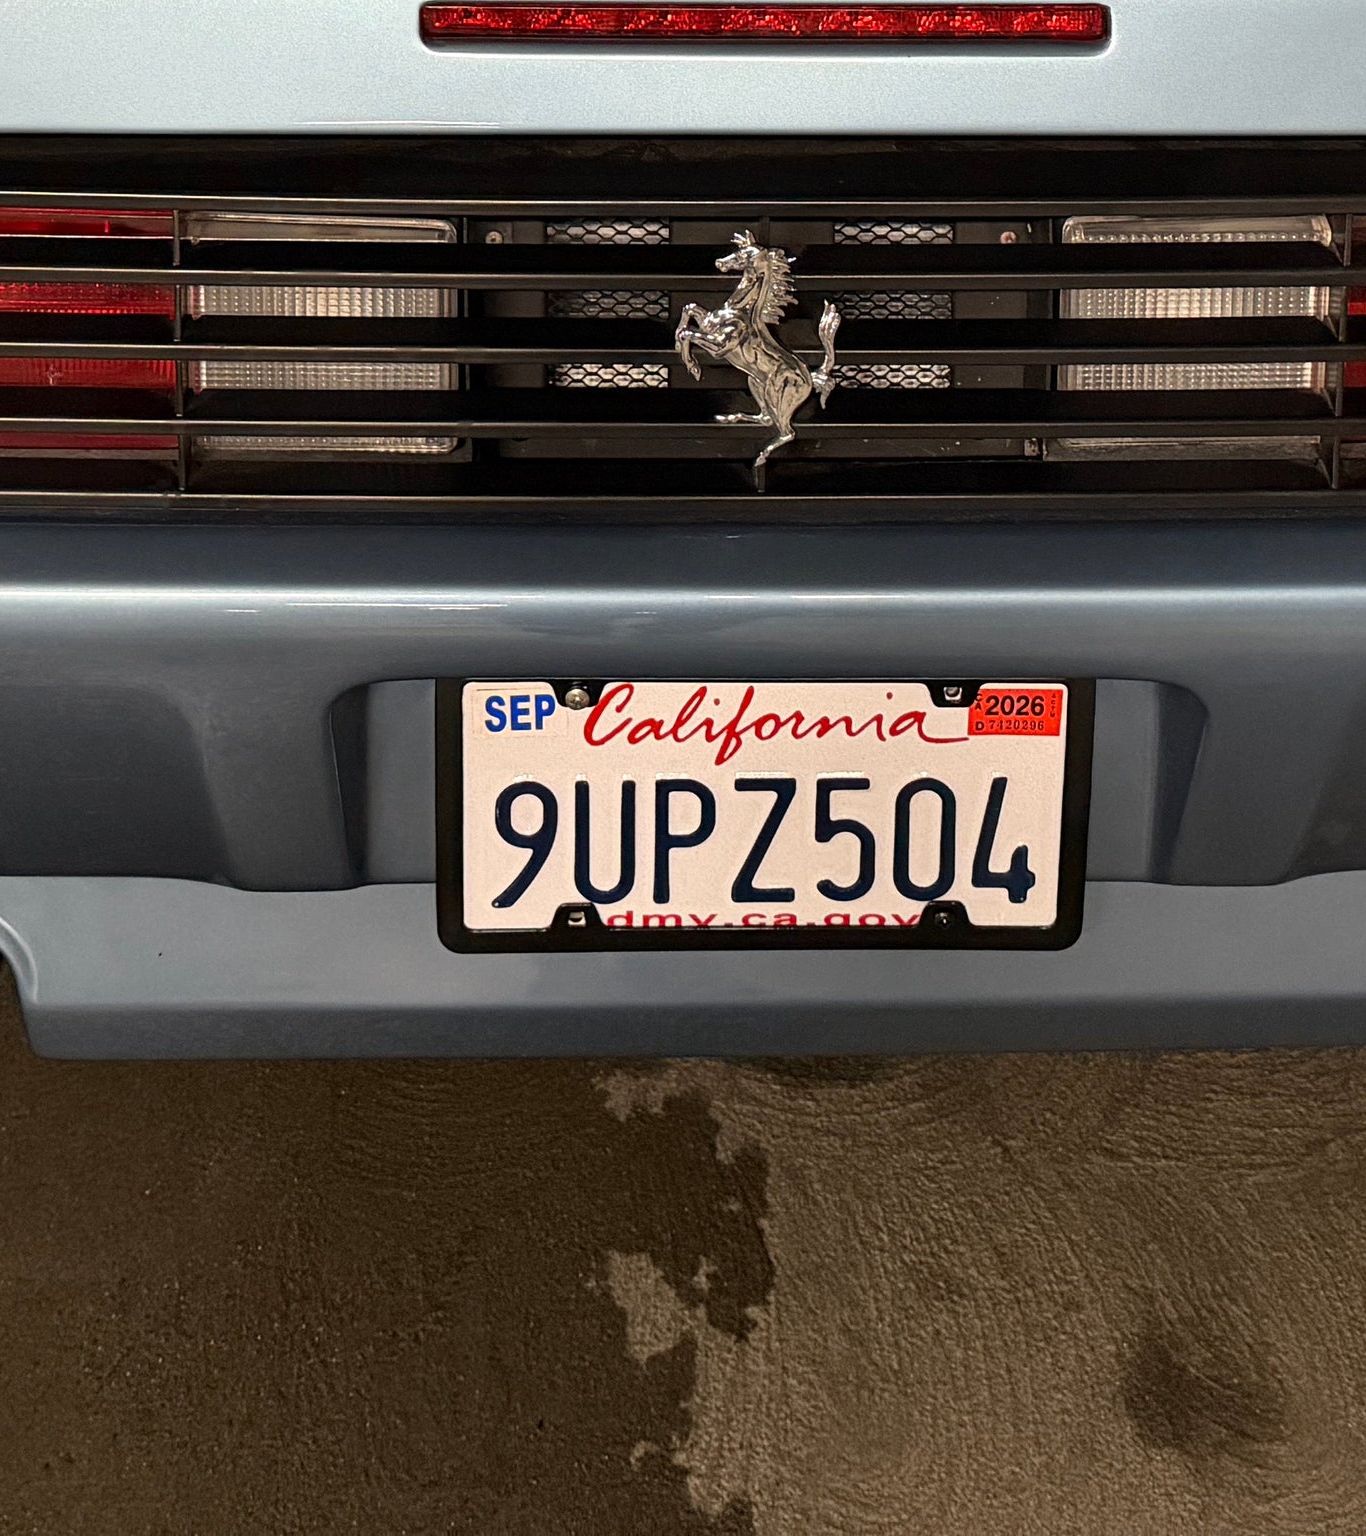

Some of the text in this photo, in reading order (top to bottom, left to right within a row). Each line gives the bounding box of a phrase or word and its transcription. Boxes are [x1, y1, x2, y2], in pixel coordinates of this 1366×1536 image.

[485, 694, 555, 732] SEP
[583, 682, 970, 766] California
[984, 695, 1045, 717] 2026
[491, 775, 1037, 908] 9UPZ504
